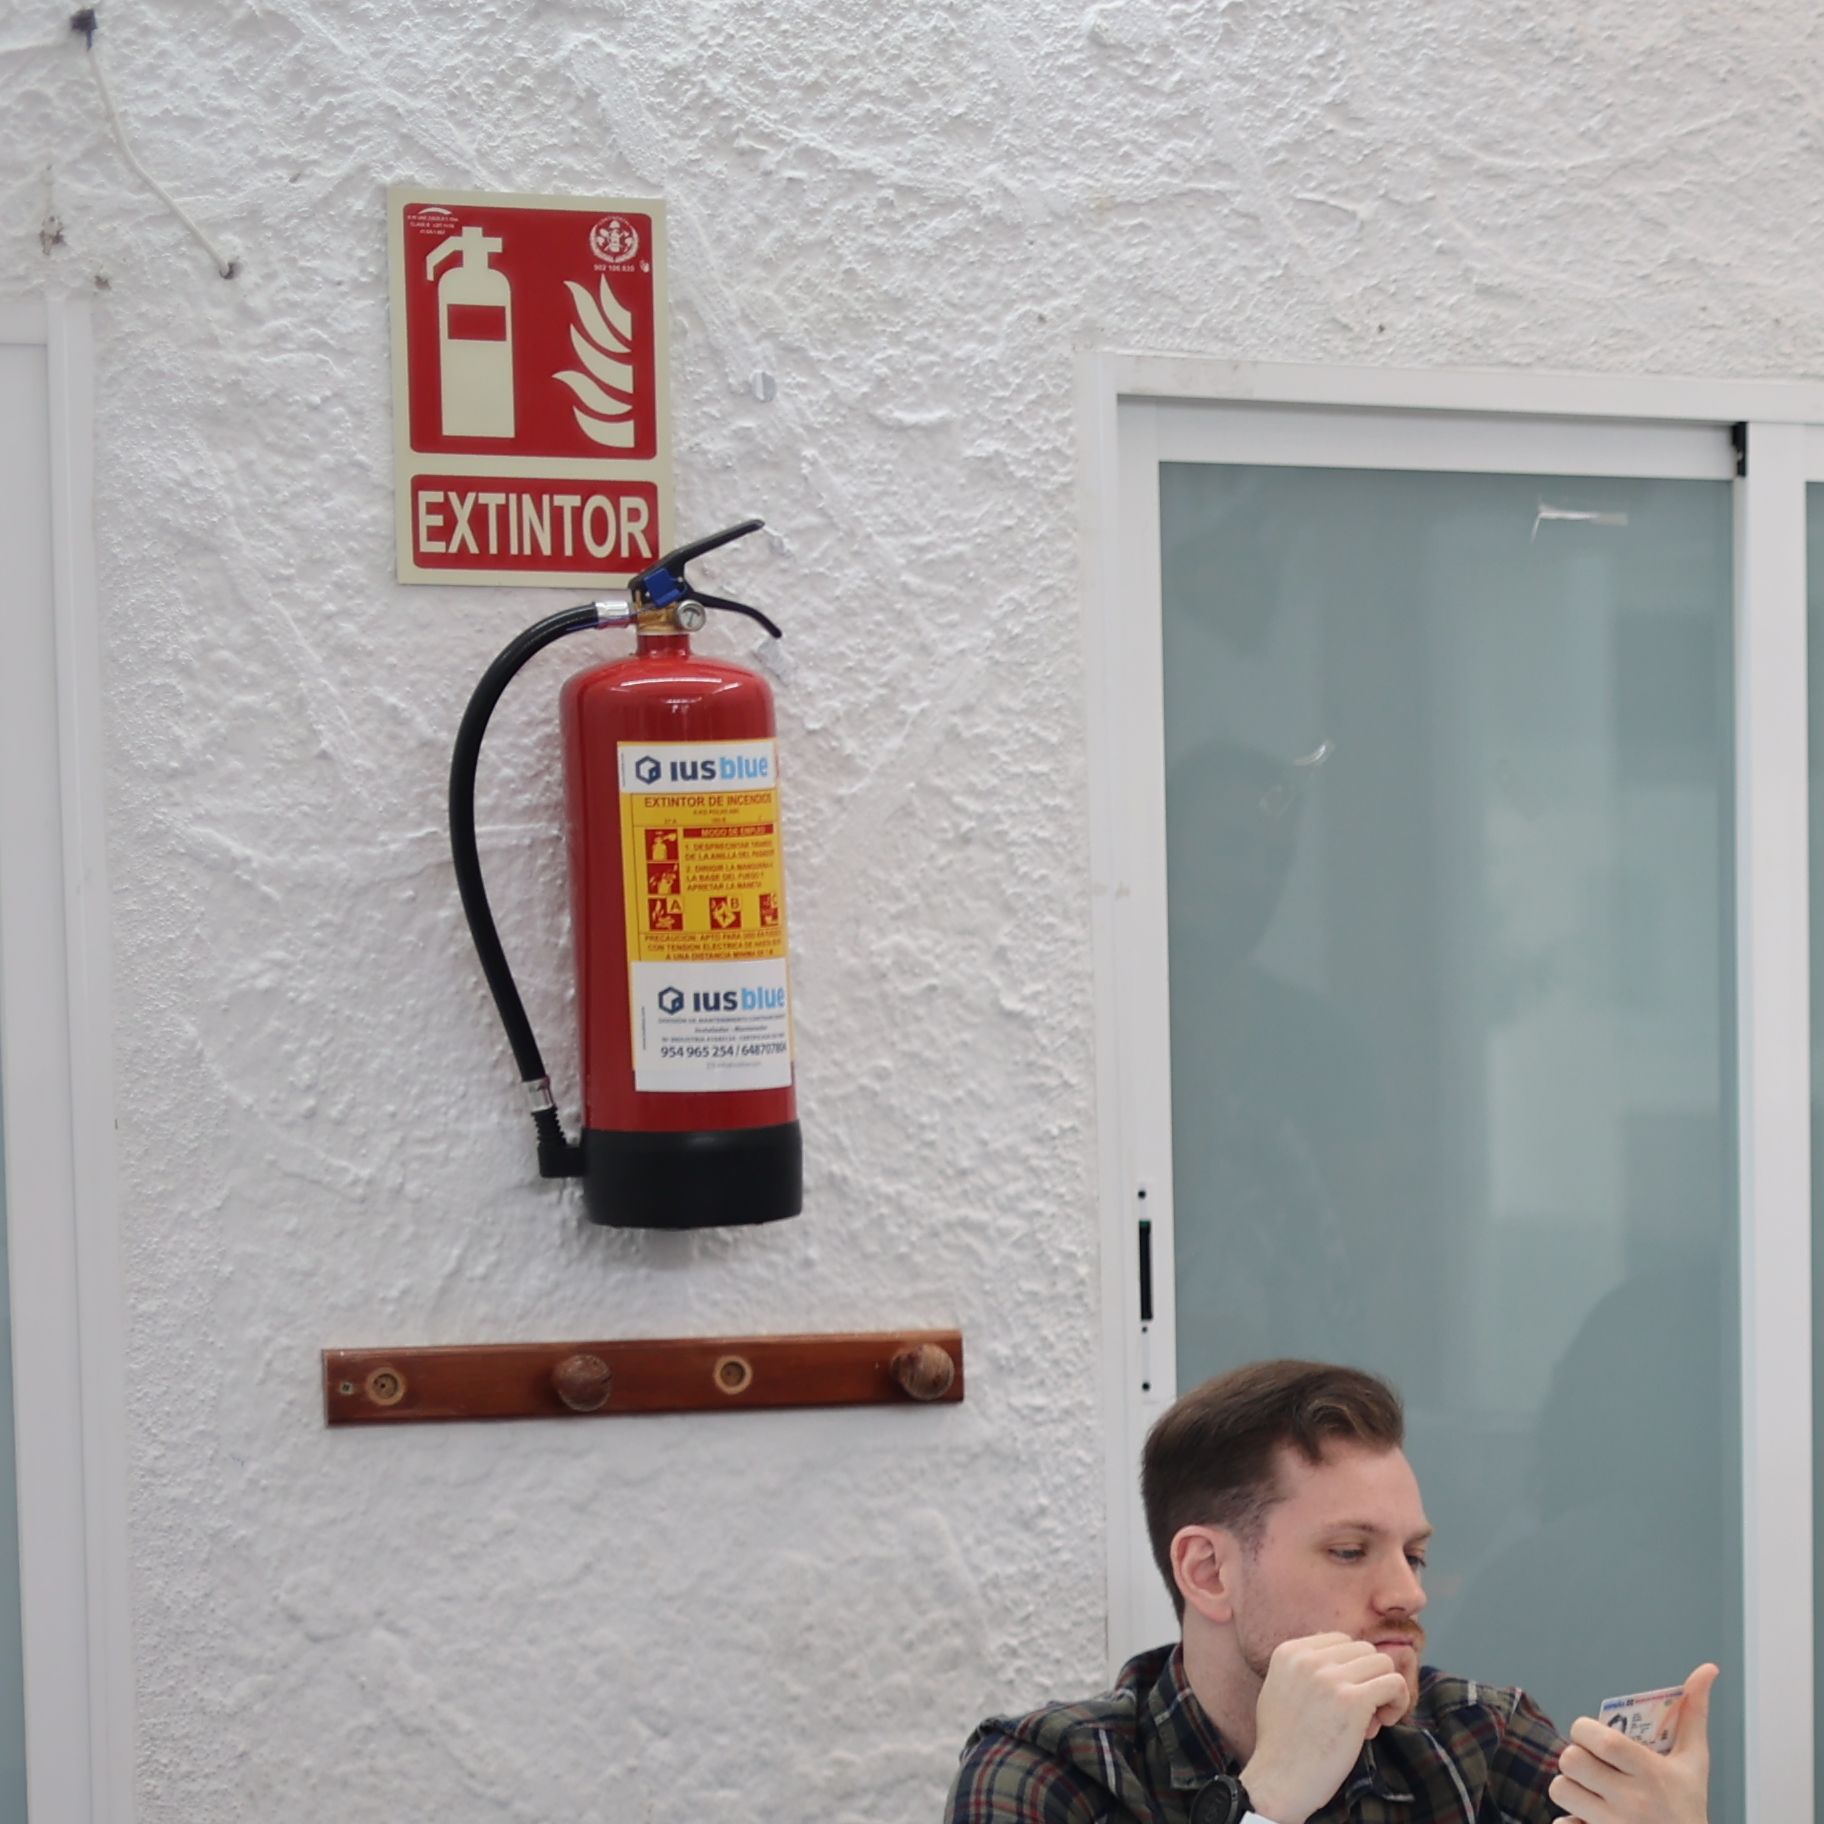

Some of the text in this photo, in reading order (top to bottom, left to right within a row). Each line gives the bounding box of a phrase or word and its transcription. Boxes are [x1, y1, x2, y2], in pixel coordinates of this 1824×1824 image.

[417, 490, 653, 559] EXTINTOR
[644, 796, 704, 808] EXTINTOR
[708, 795, 724, 806] DE
[670, 899, 681, 910] A
[730, 898, 740, 910] B
[660, 1046, 684, 1058] 954
[686, 1046, 710, 1058] 965
[712, 1044, 734, 1058] 254
[736, 1044, 740, 1056] /
